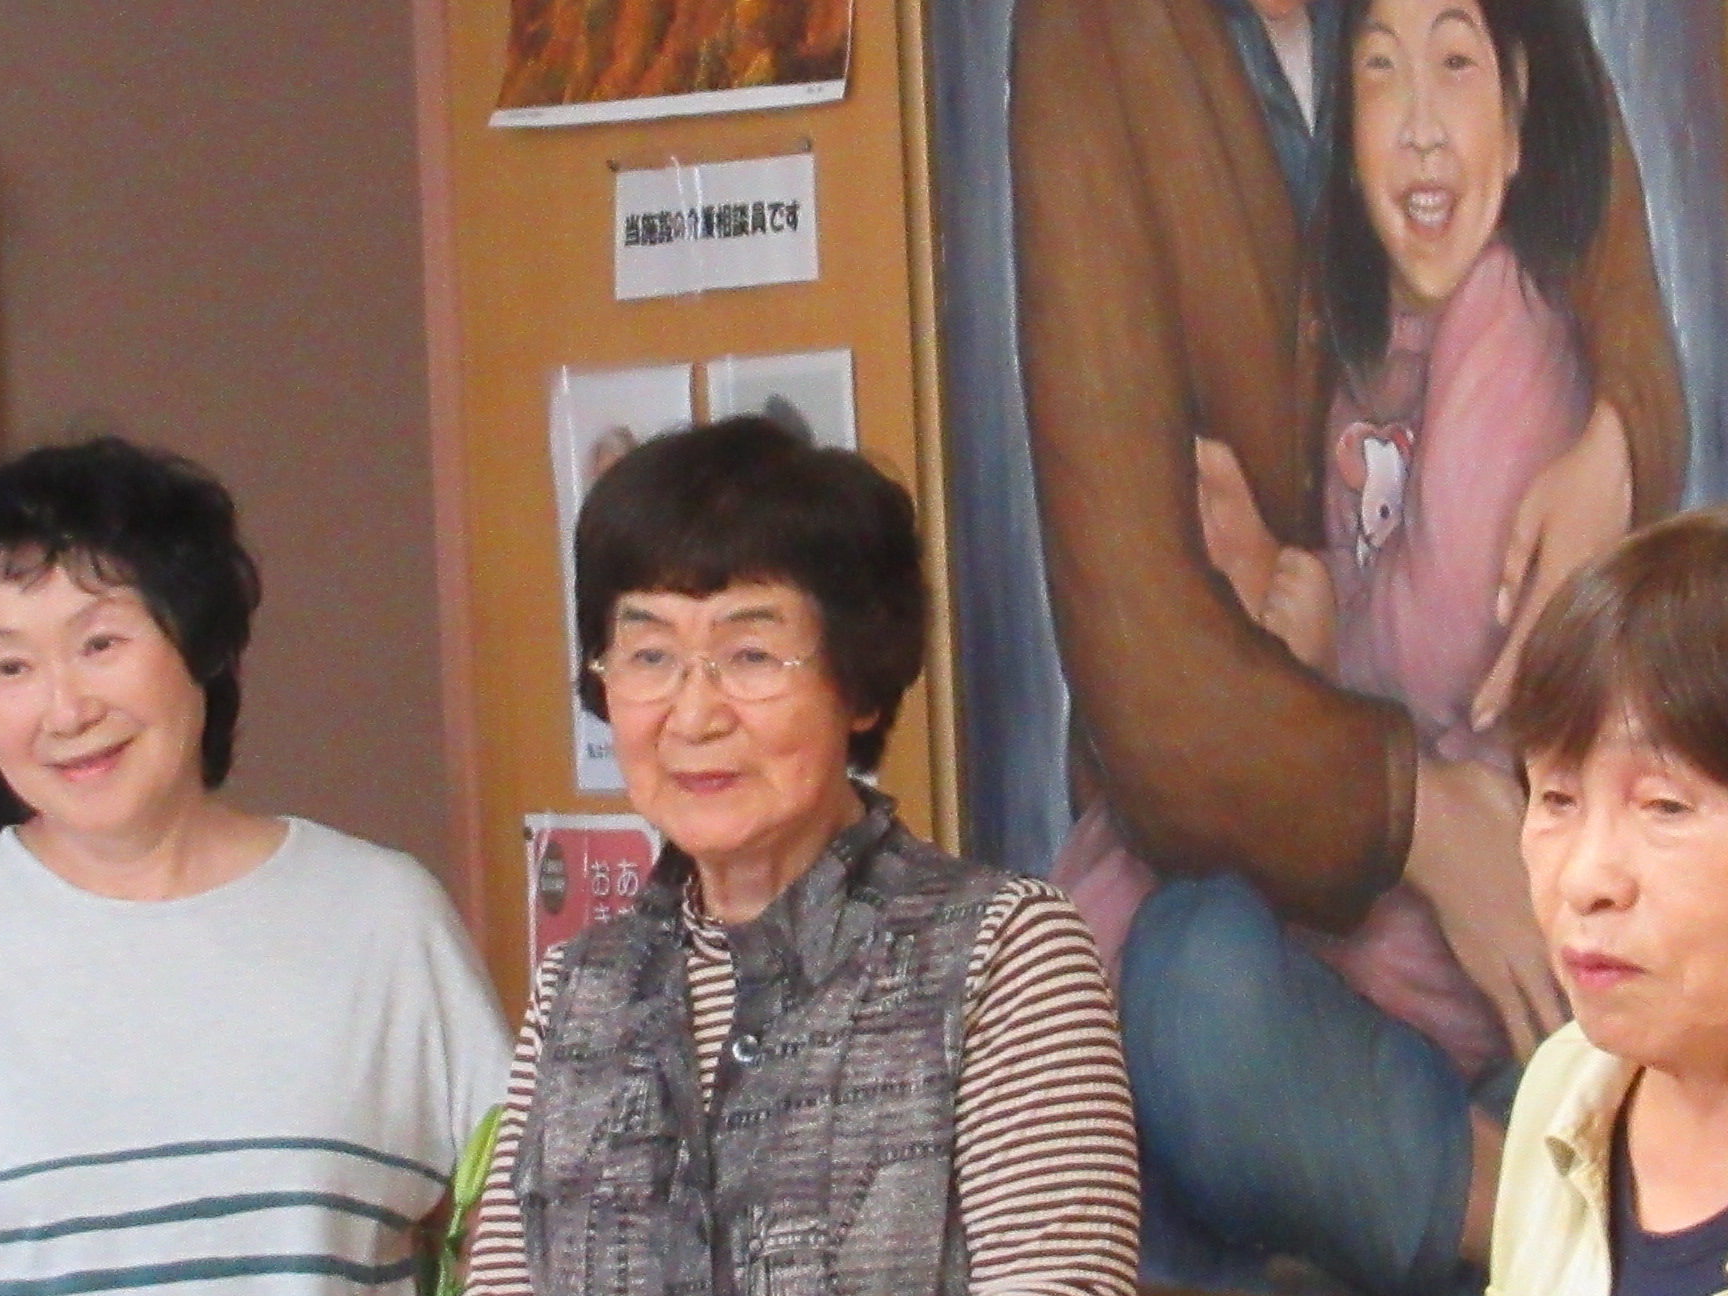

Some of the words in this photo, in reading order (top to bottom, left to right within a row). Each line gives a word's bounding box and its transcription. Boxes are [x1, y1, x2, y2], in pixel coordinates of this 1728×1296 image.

[623, 197, 801, 247] 当施設の介護相談員です
